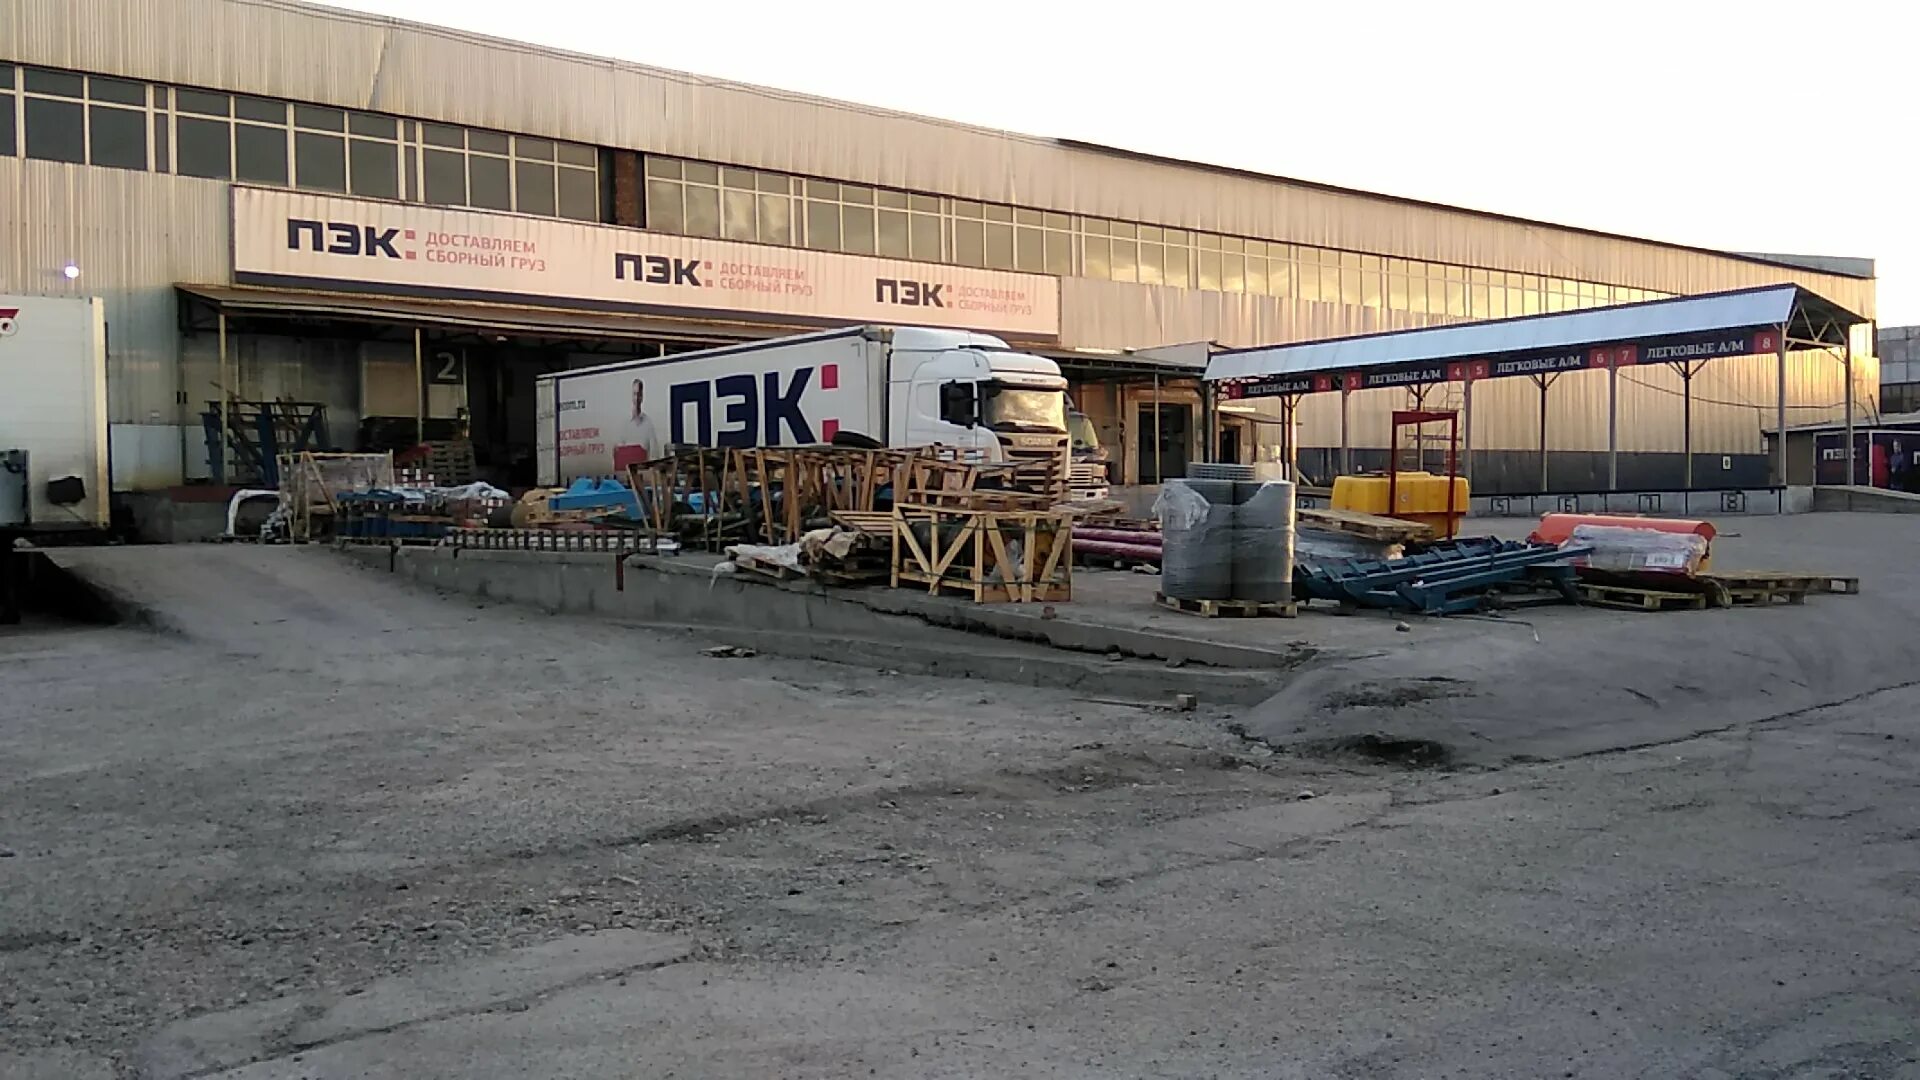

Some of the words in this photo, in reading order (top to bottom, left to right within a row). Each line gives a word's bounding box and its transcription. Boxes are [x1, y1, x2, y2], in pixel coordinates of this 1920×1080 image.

[425, 231, 536, 254] ДОСТАВЛЯЕМ
[426, 249, 505, 268] СБОРНЫЙ
[510, 256, 546, 272] ГРУЗ
[720, 262, 805, 281] ДОСТАВЛЯЕМ
[720, 278, 781, 293] СБОРНЫЙ
[785, 284, 814, 297] ГРУЗ
[958, 285, 1025, 300] ДОСТАВЛЯЕМ
[1622, 350, 1630, 361] 7
[1647, 342, 1716, 359] ЛЕГКОВЫЕ
[1718, 340, 1745, 353] А/М
[1762, 337, 1771, 349] 8
[437, 352, 457, 379] 2
[1497, 357, 1557, 373] ЛЕГКОВЫЕ
[1558, 355, 1582, 367] А/М
[1596, 353, 1604, 364] 6
